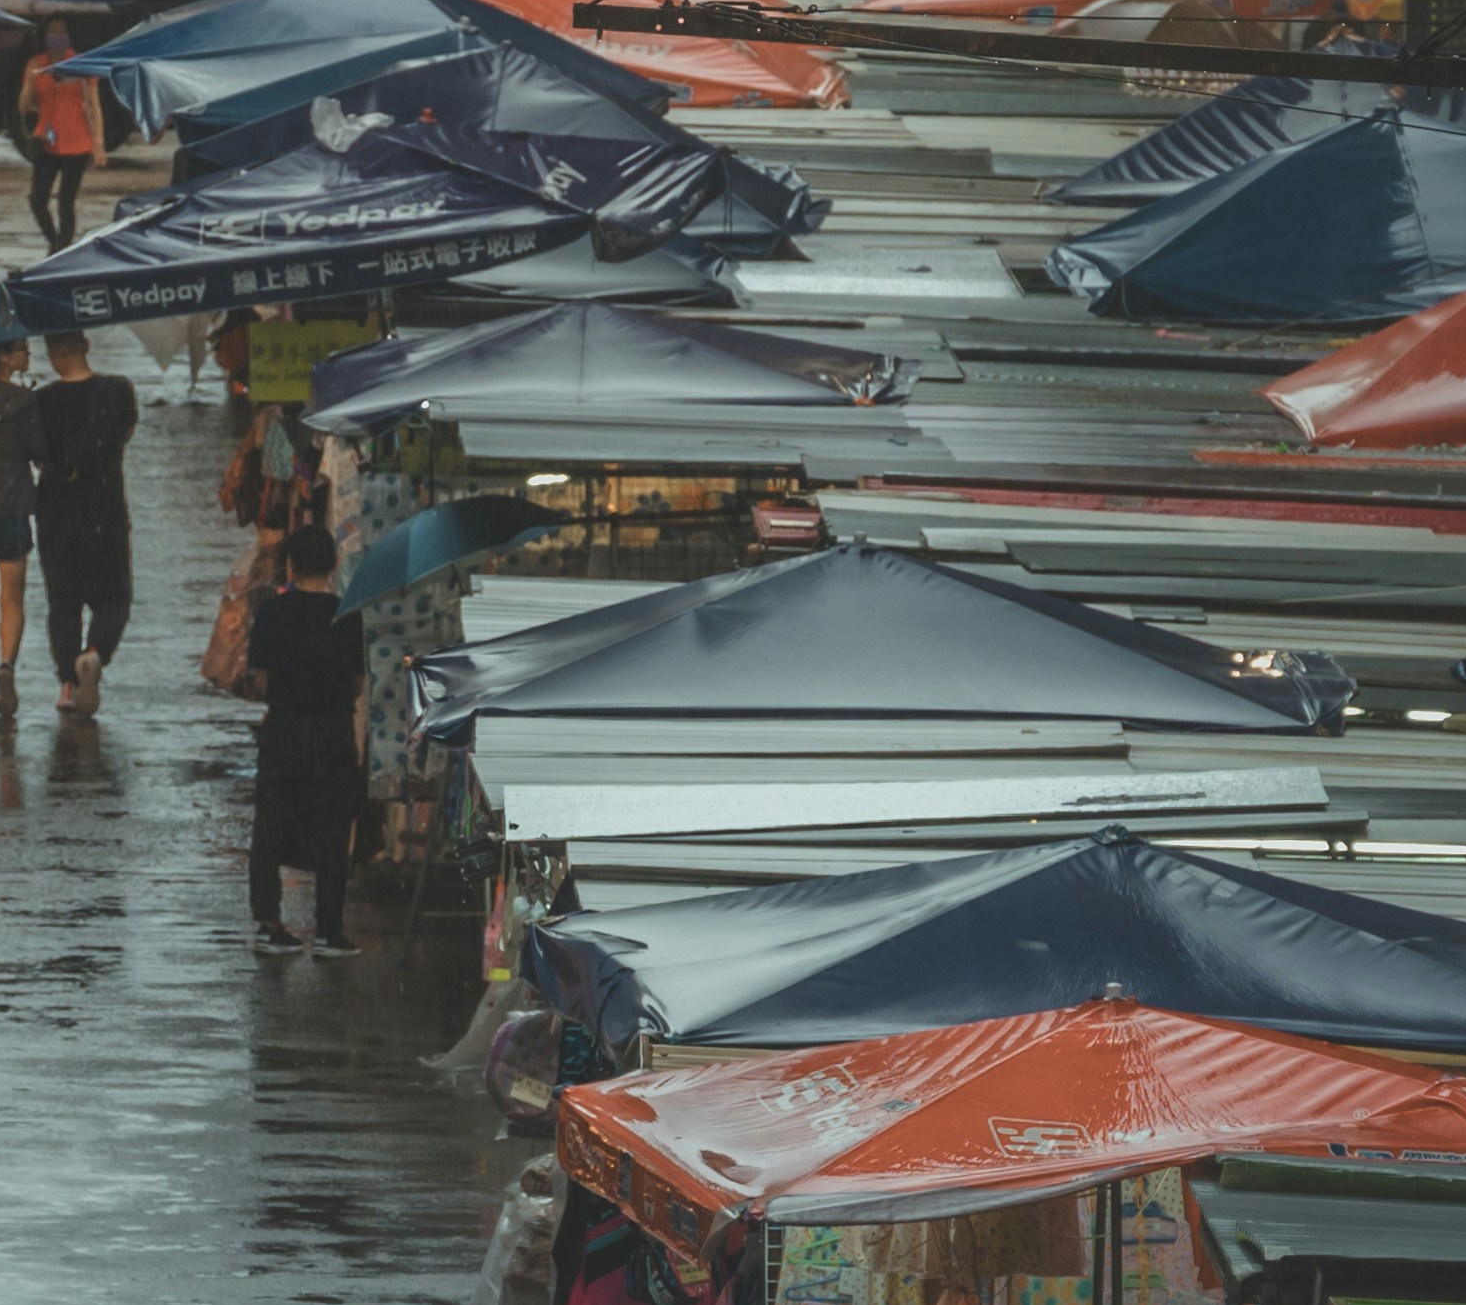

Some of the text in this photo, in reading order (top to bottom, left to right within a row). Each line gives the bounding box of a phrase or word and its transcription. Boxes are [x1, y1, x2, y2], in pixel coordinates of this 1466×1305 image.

[115, 277, 207, 313] Yedpay
[231, 260, 336, 299] 線上線下
